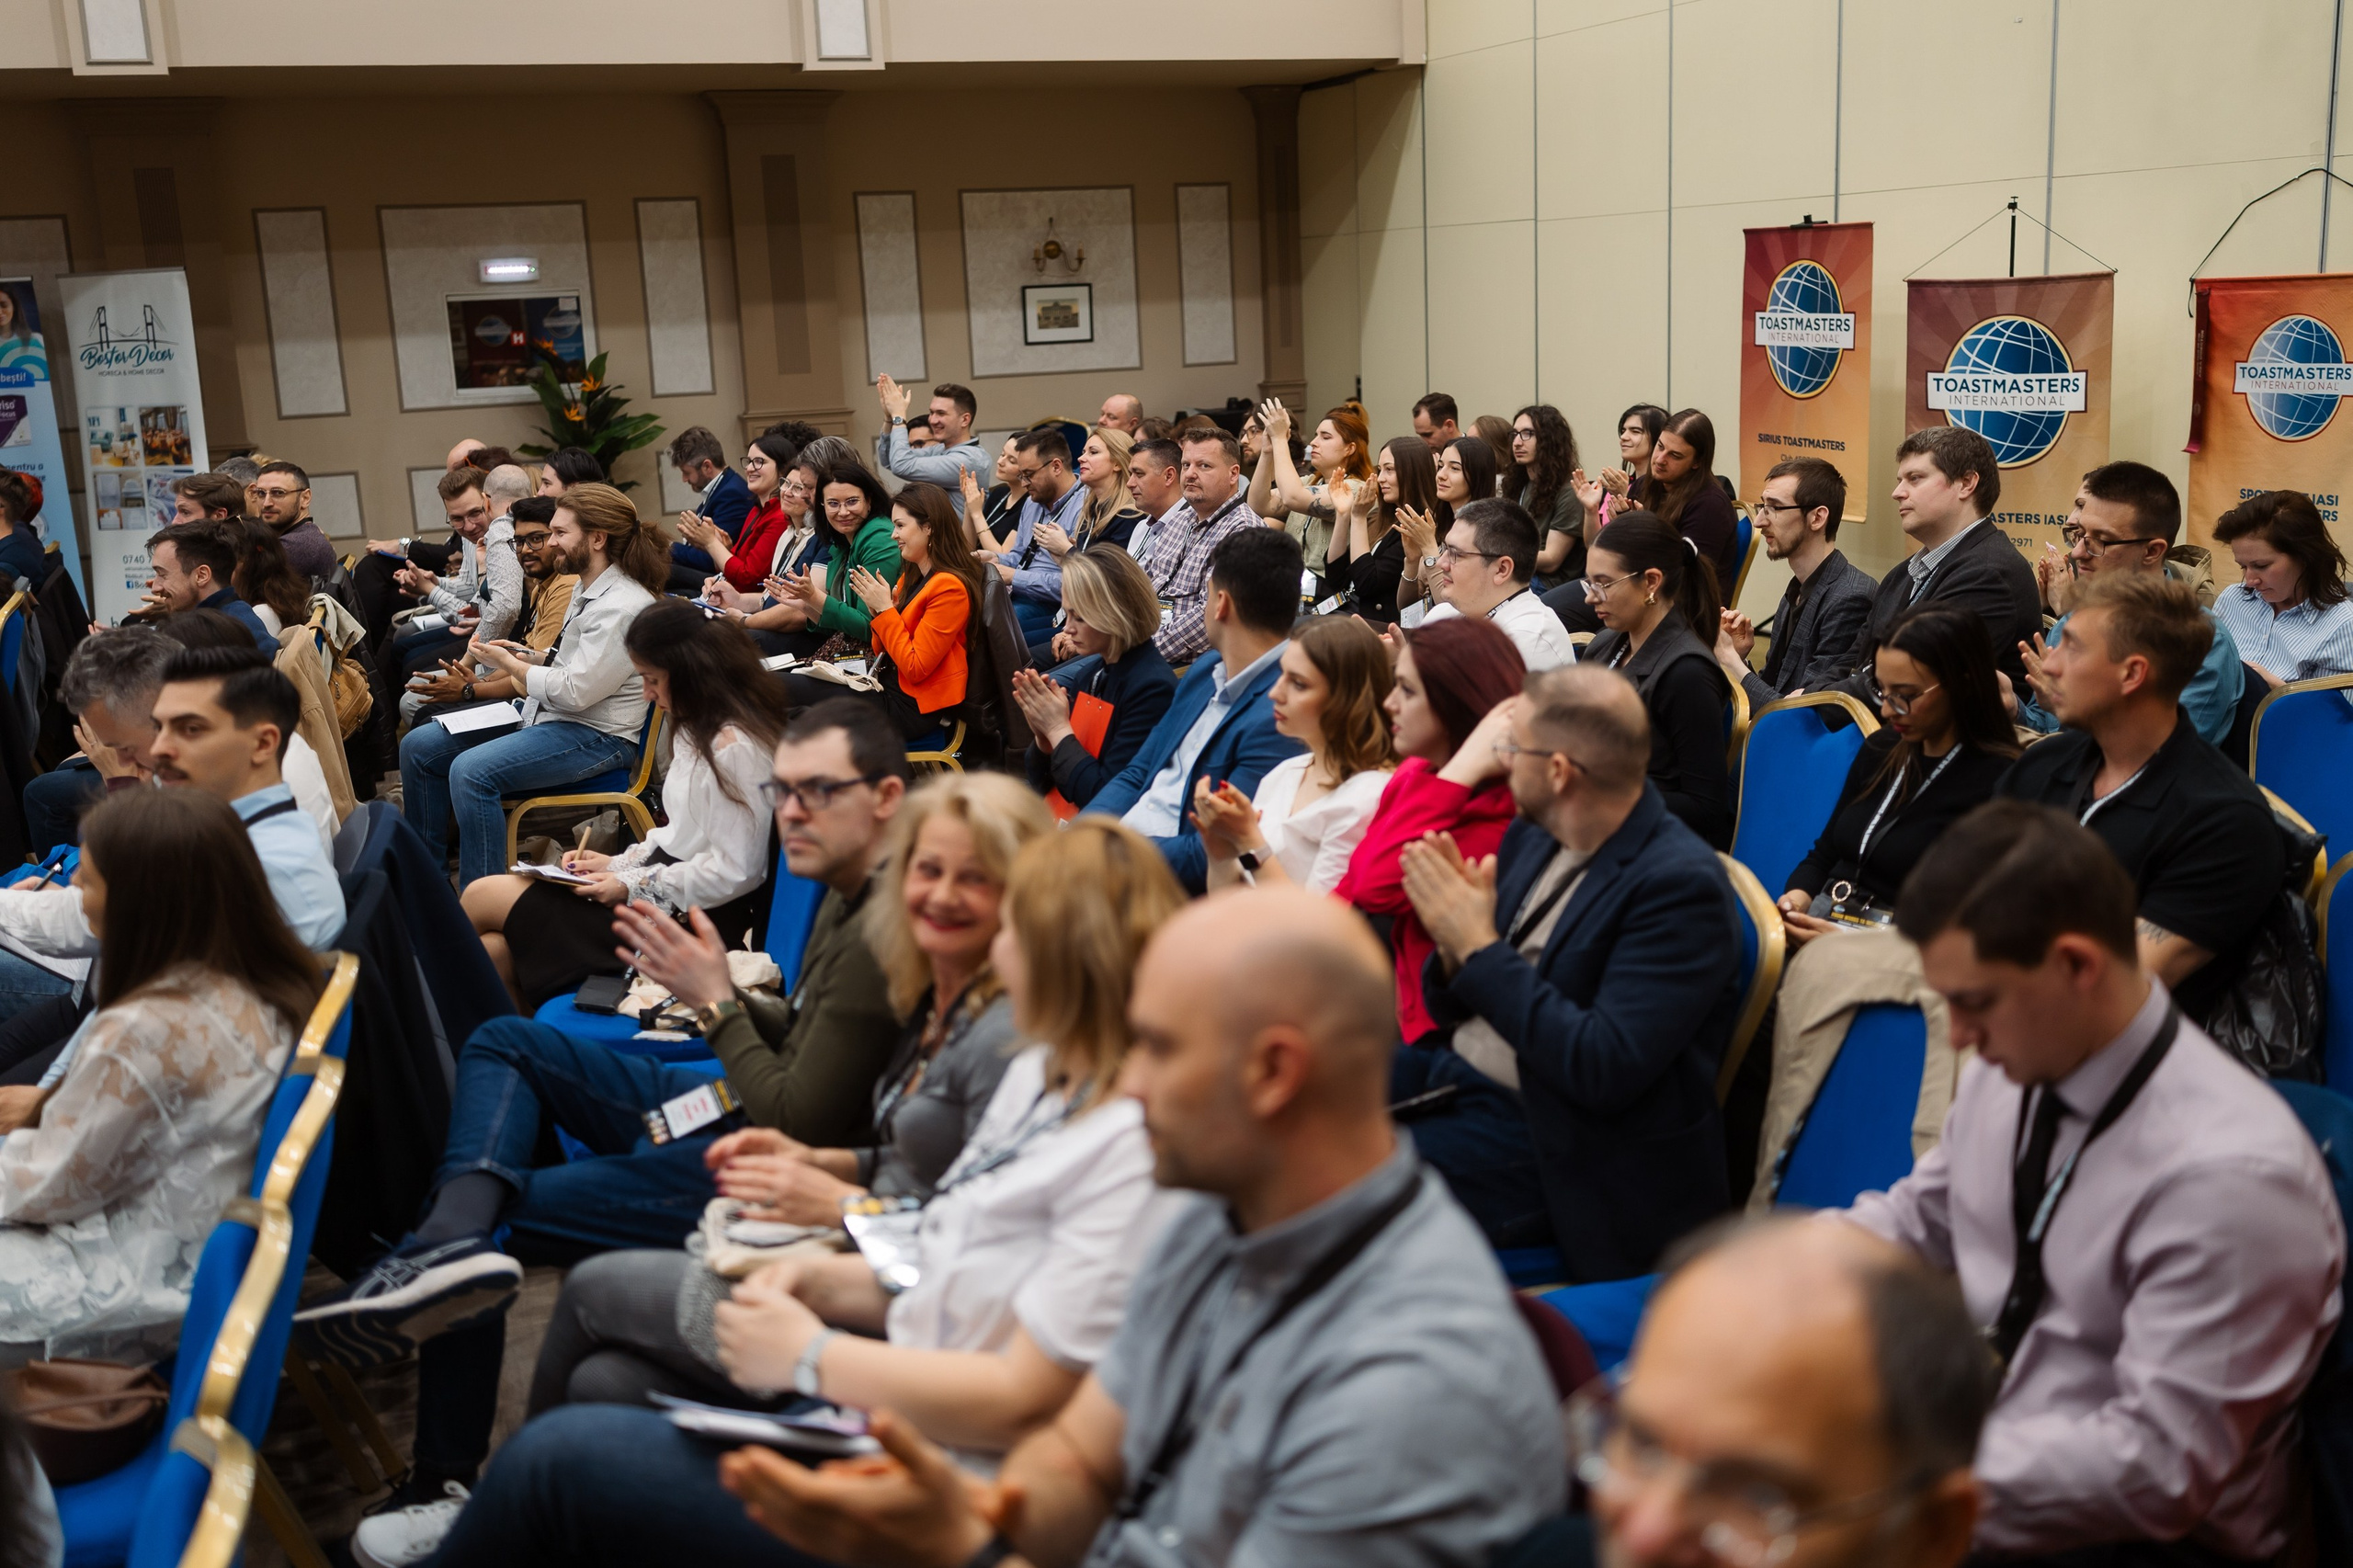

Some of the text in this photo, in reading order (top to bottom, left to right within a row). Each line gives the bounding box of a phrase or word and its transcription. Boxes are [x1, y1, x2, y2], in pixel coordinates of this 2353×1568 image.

[1759, 316, 1850, 332] TOASTMASTERS
[1768, 332, 1840, 344] INTERNATIONAL
[129, 343, 174, 368] Decor
[2240, 366, 2352, 381] TOASTMASTERS
[1933, 377, 2080, 393] TOASTMASTERS
[2251, 380, 2339, 391] INTERNATIONAL
[1949, 395, 2065, 406] INTERNATIONAL
[1757, 433, 1846, 451] SIRIUS TOASTMASTERS
[2313, 494, 2339, 506] IASI
[1990, 512, 2040, 524] ASTERS
[2011, 538, 2033, 547] 2971
[122, 554, 145, 564] 0740
